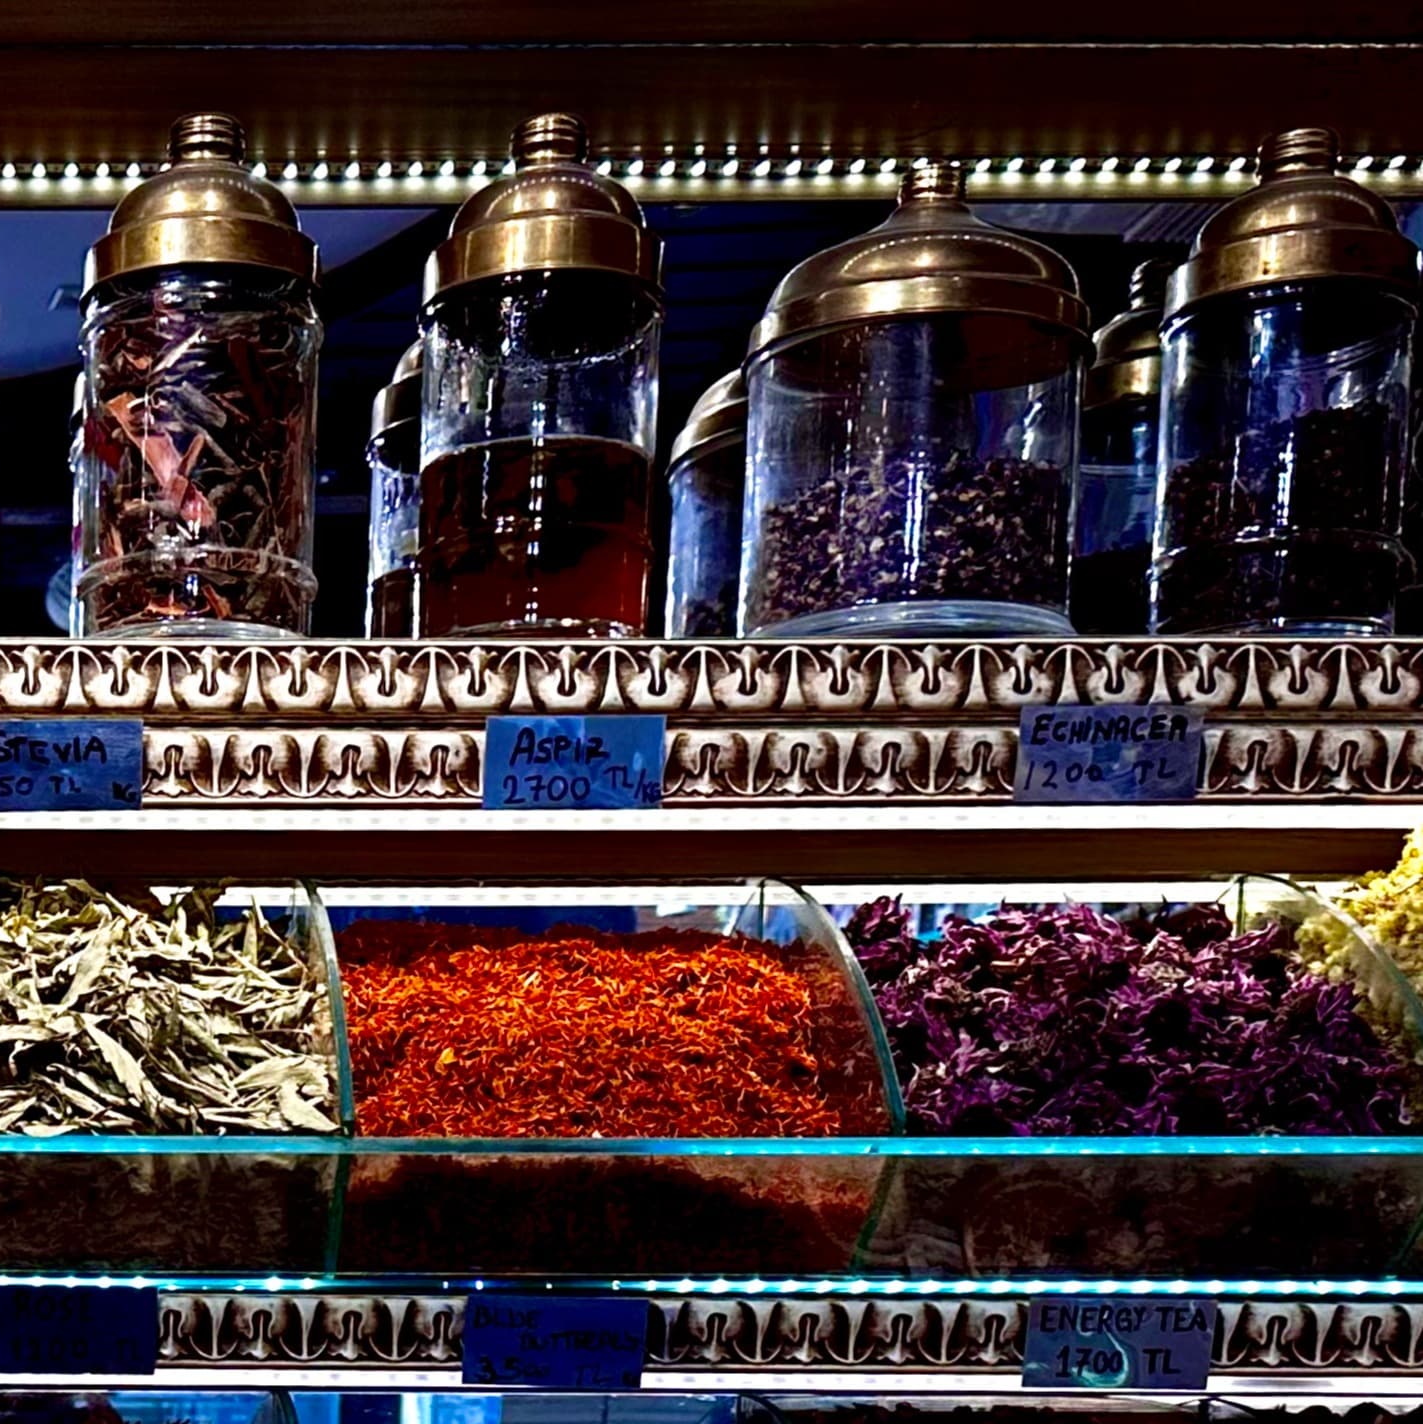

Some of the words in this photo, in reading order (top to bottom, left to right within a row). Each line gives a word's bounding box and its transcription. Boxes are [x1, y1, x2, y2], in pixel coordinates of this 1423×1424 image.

[1030, 713, 1189, 745] ECHINACEA
[49, 775, 82, 795] TL
[503, 774, 591, 805] 2700
[1023, 759, 1104, 791] 1200
[1132, 757, 1177, 786] TL
[1039, 1304, 1147, 1334] ENERGY
[1156, 1305, 1208, 1333] TEA
[1055, 1344, 1124, 1379] 1700
[1143, 1348, 1182, 1375] TL
